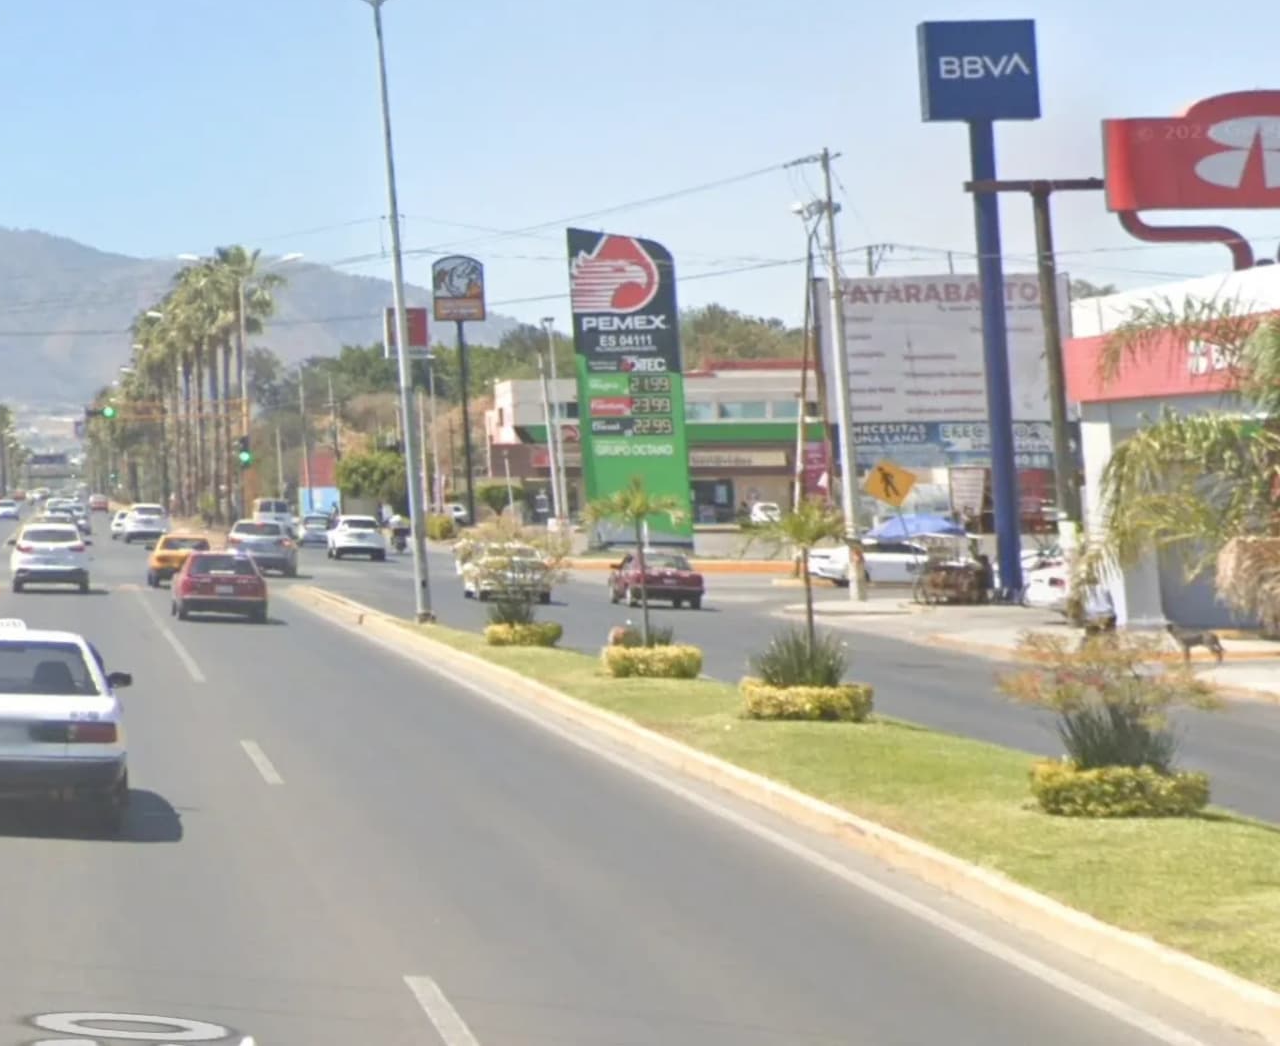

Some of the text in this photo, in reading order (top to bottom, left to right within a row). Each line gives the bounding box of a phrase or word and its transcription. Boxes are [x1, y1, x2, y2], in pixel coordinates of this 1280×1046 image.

[939, 52, 1030, 79] BBVA
[581, 315, 666, 331] PEMEX
[599, 335, 617, 347] ES
